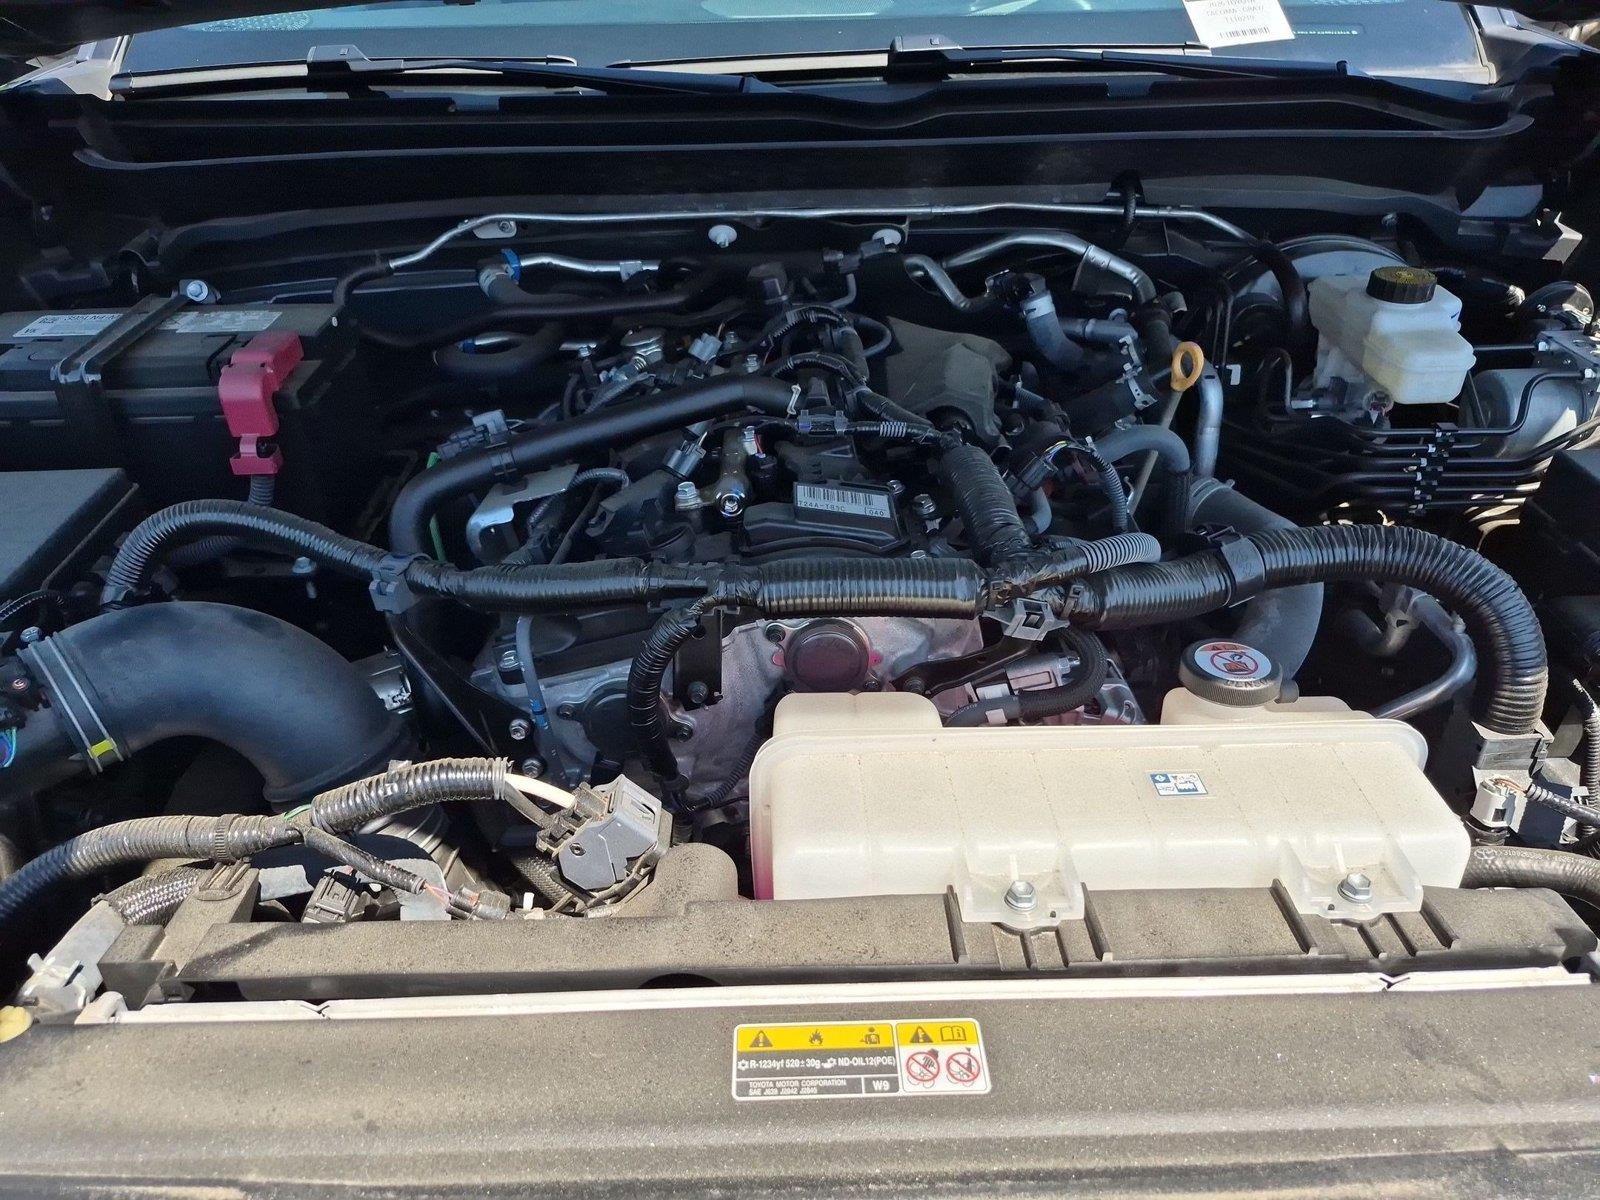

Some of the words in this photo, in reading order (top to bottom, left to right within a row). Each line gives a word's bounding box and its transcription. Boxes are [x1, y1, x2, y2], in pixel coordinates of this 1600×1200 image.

[749, 1059, 785, 1070] R-1234yf
[801, 1078, 846, 1087] CORPORATION
[872, 1080, 891, 1092] W9
